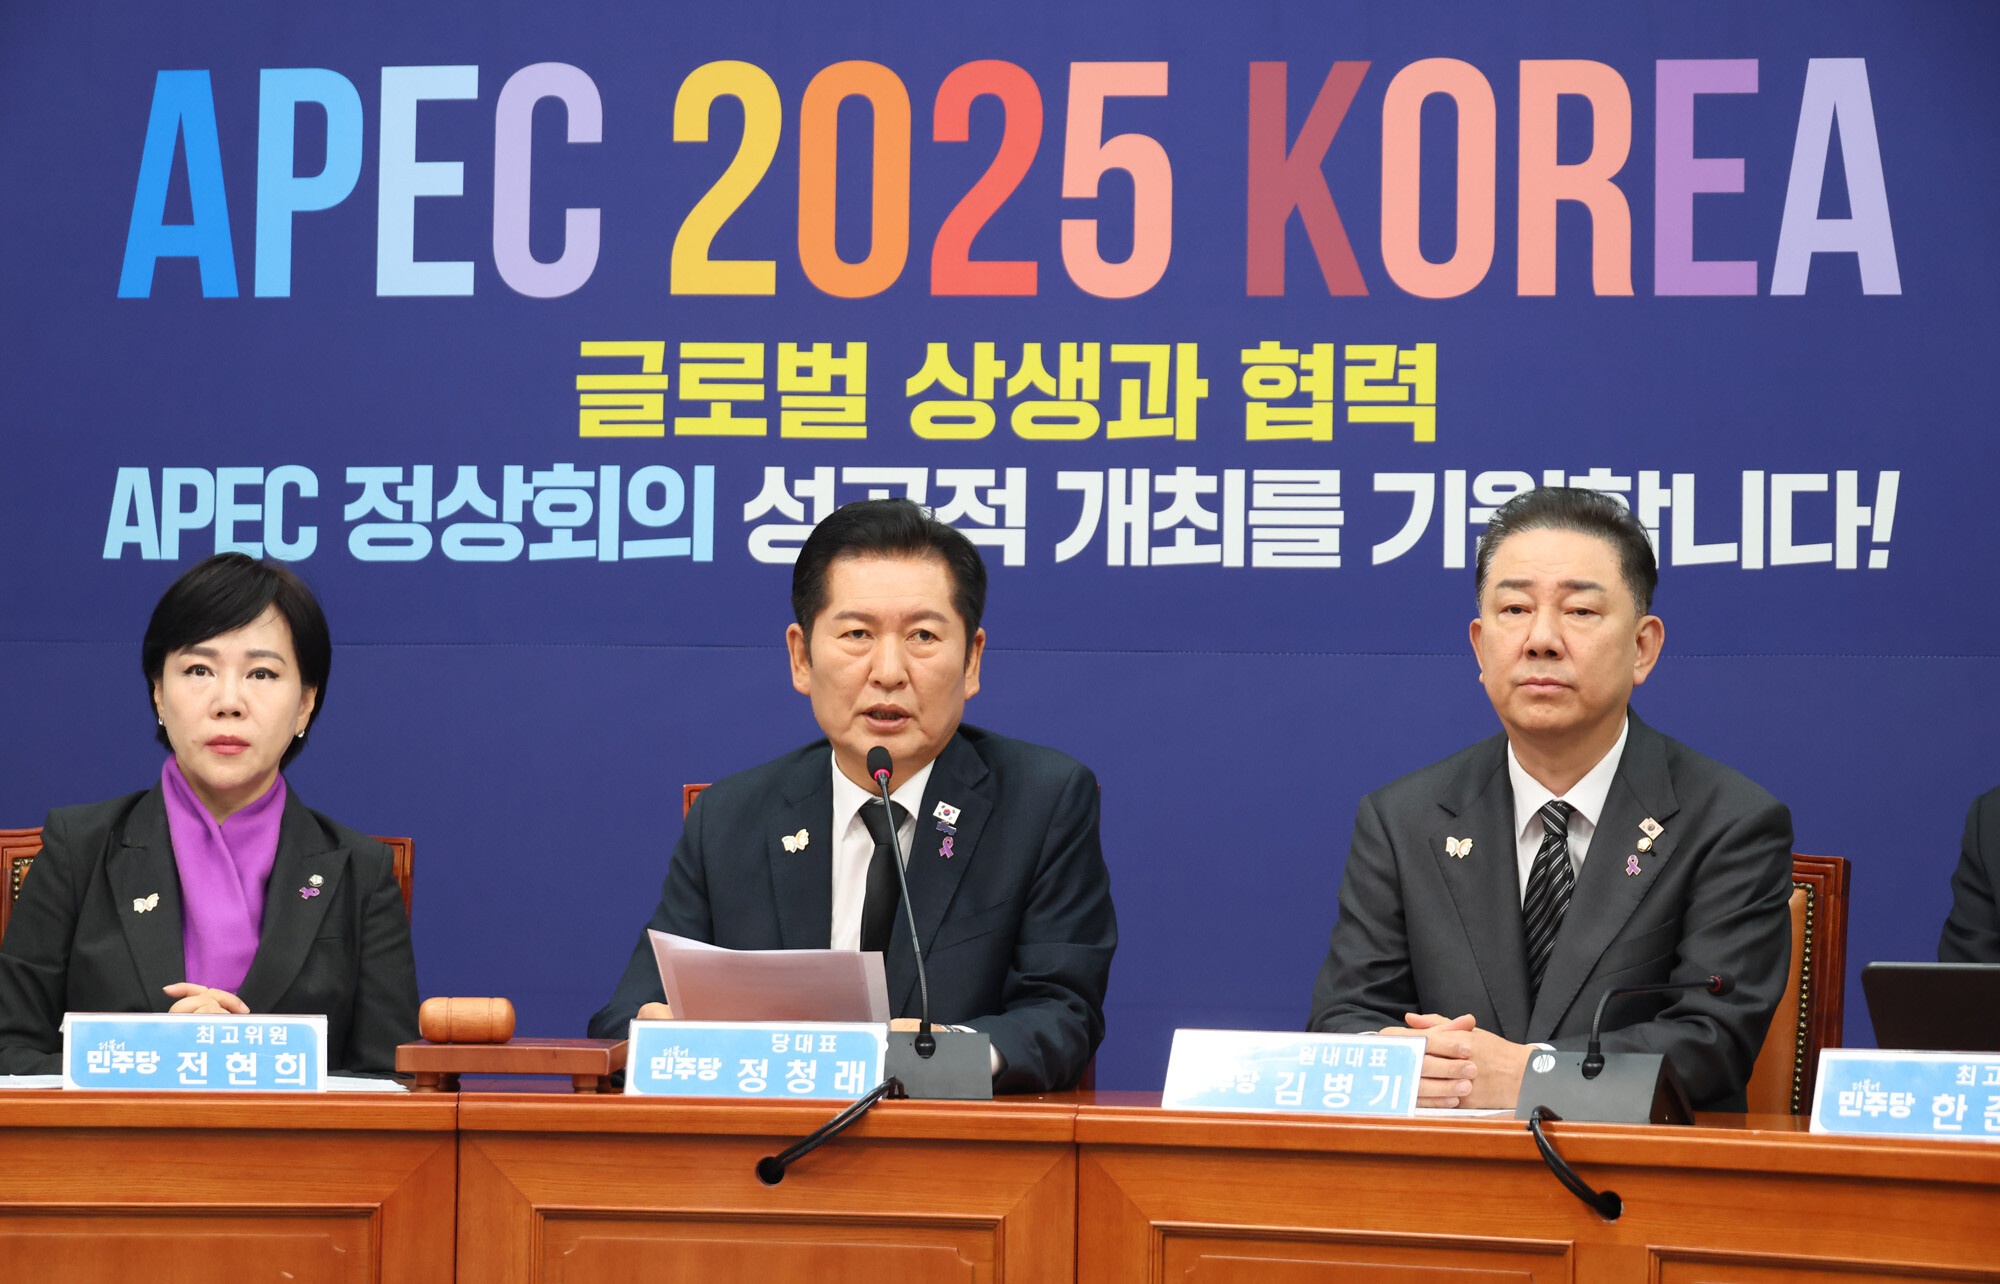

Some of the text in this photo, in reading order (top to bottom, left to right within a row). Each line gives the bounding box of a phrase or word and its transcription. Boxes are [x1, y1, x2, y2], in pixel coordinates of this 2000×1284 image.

[117, 57, 1902, 299] APEC 2025 KOREA
[576, 340, 1437, 442] 글로벌 상생과 협력
[102, 464, 319, 561] APEC
[343, 463, 715, 562] 정상회의
[1055, 466, 1345, 568] 개최를
[1371, 467, 1900, 570] 기니다!
[196, 1025, 288, 1046] 최고위원
[772, 1033, 838, 1054] 당대표
[87, 1050, 161, 1075] 민주당
[651, 1056, 722, 1081] 민주당
[1300, 1046, 1388, 1068] 원내대표
[1838, 1090, 1916, 1119] 민주당
